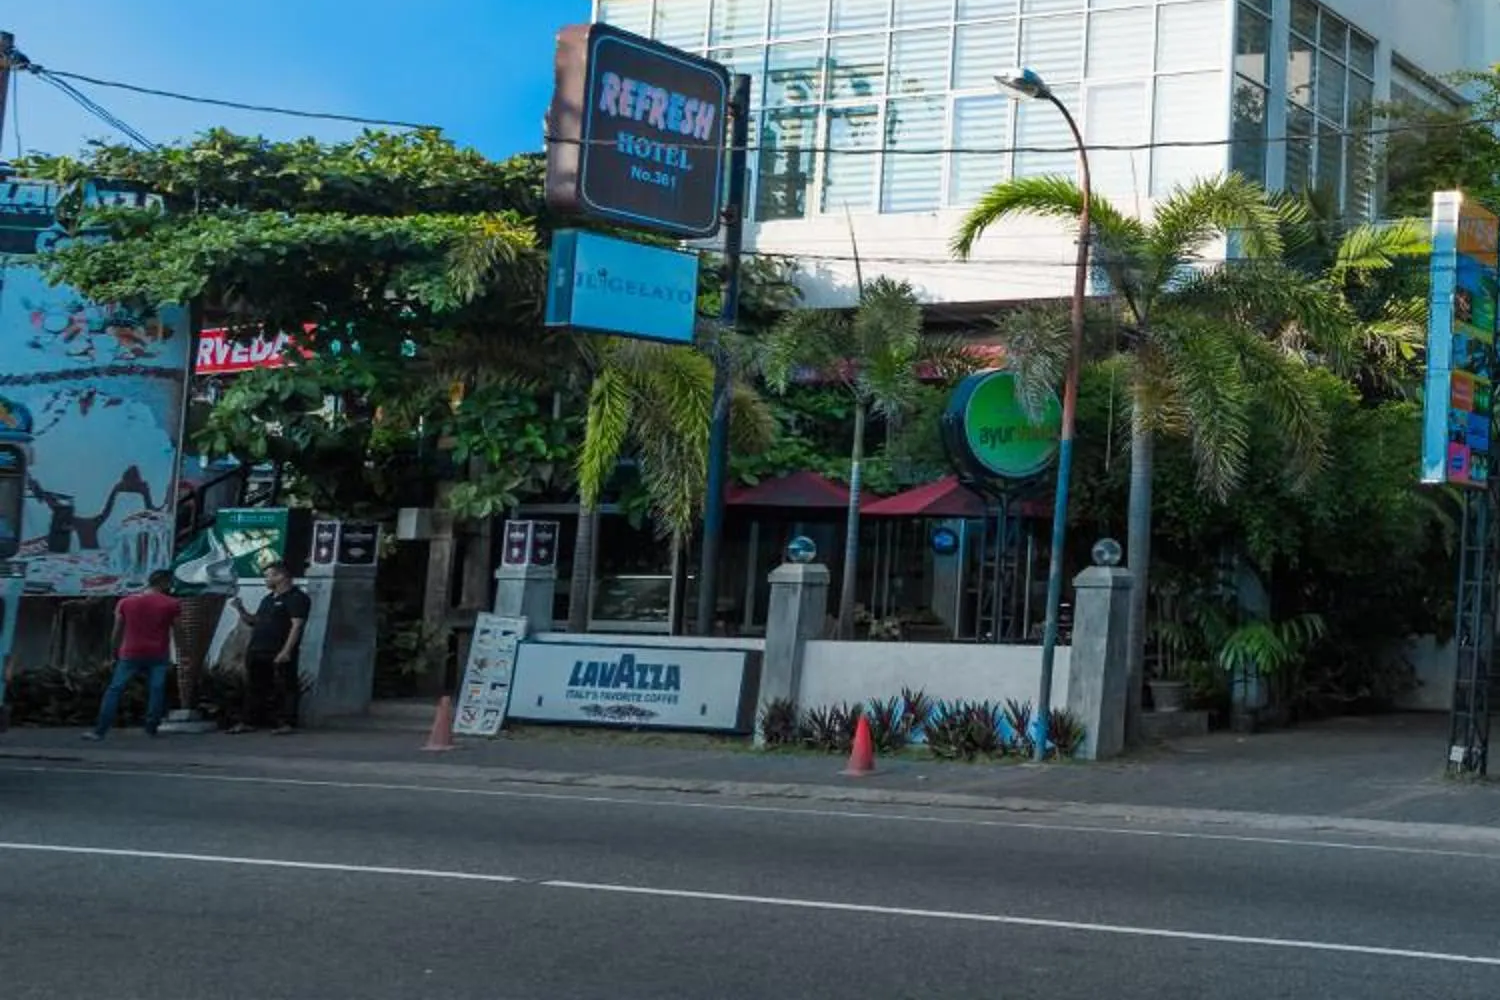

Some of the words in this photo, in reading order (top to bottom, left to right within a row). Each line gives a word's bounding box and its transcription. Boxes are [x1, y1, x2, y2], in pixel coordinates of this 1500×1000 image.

[599, 71, 716, 141] REFRESH
[616, 131, 693, 171] HOTEL
[608, 276, 693, 305] GELATO
[568, 653, 681, 691] LAVAZZA
[643, 692, 679, 705] COFFEE
